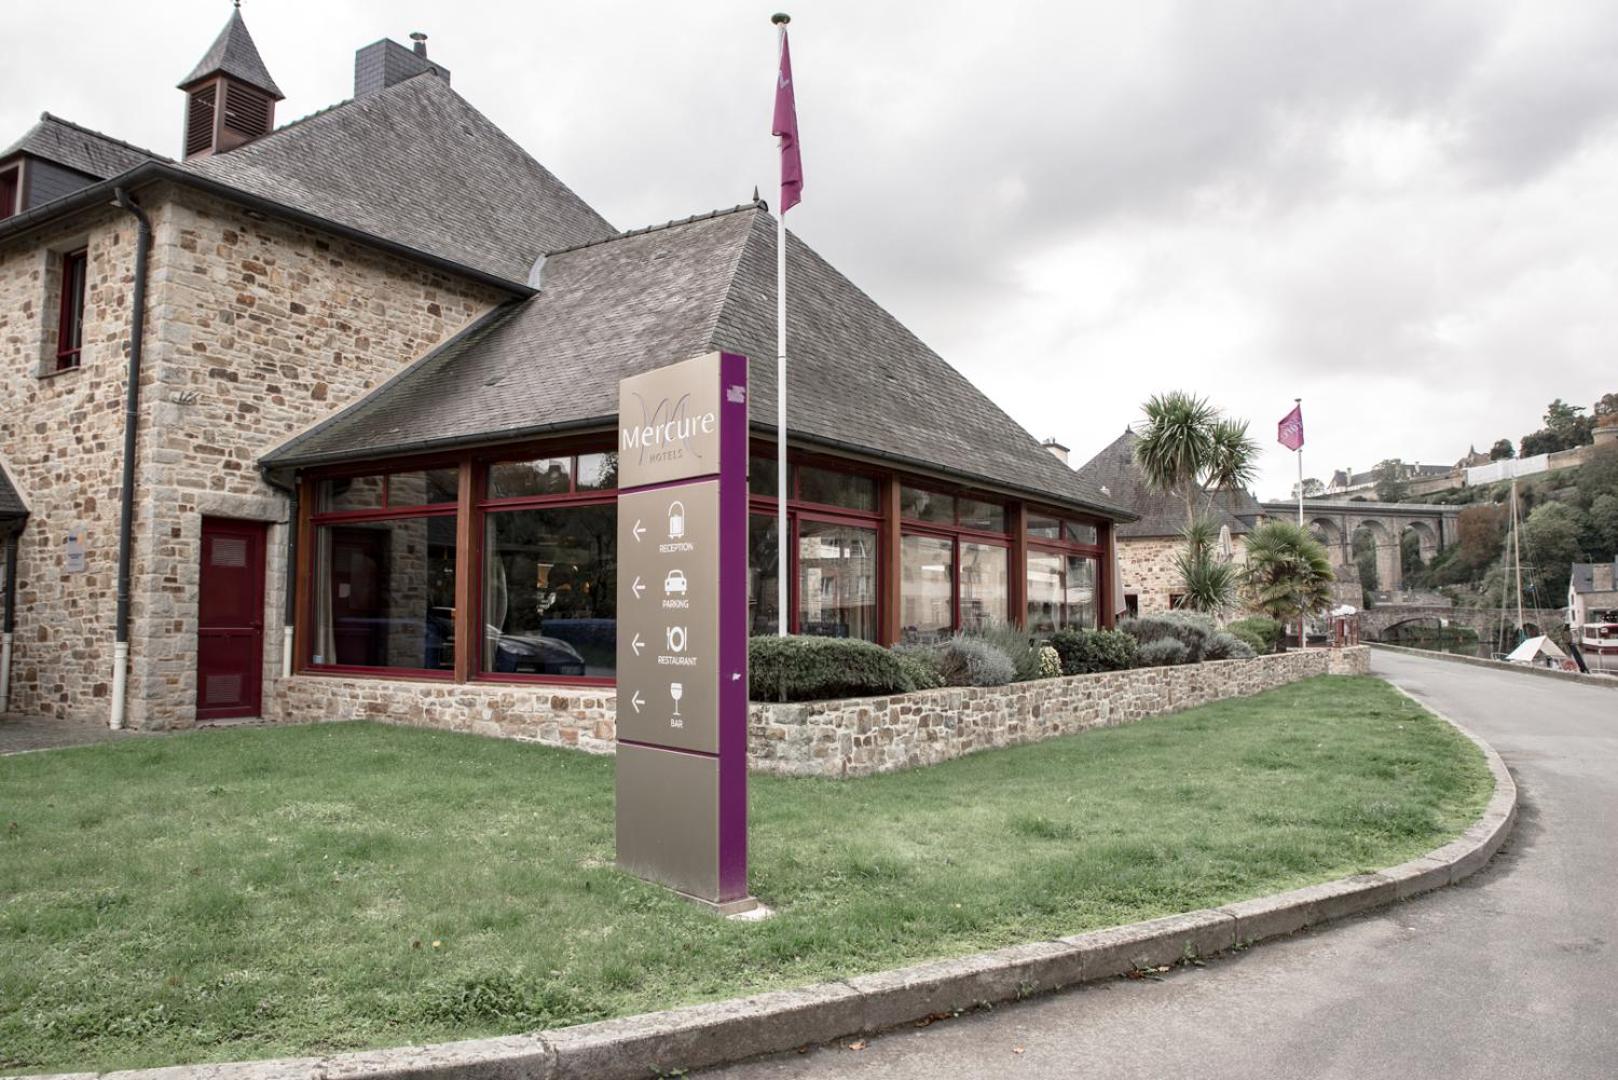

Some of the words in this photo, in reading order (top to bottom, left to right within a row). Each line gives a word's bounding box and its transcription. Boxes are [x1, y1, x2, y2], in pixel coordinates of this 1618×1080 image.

[622, 412, 715, 451] Mercure
[649, 448, 683, 461] HOTELS
[660, 543, 693, 553] RECEPTION
[662, 599, 689, 609] PARKING
[657, 655, 697, 666] RESTAURANT
[671, 718, 683, 728] BAR
